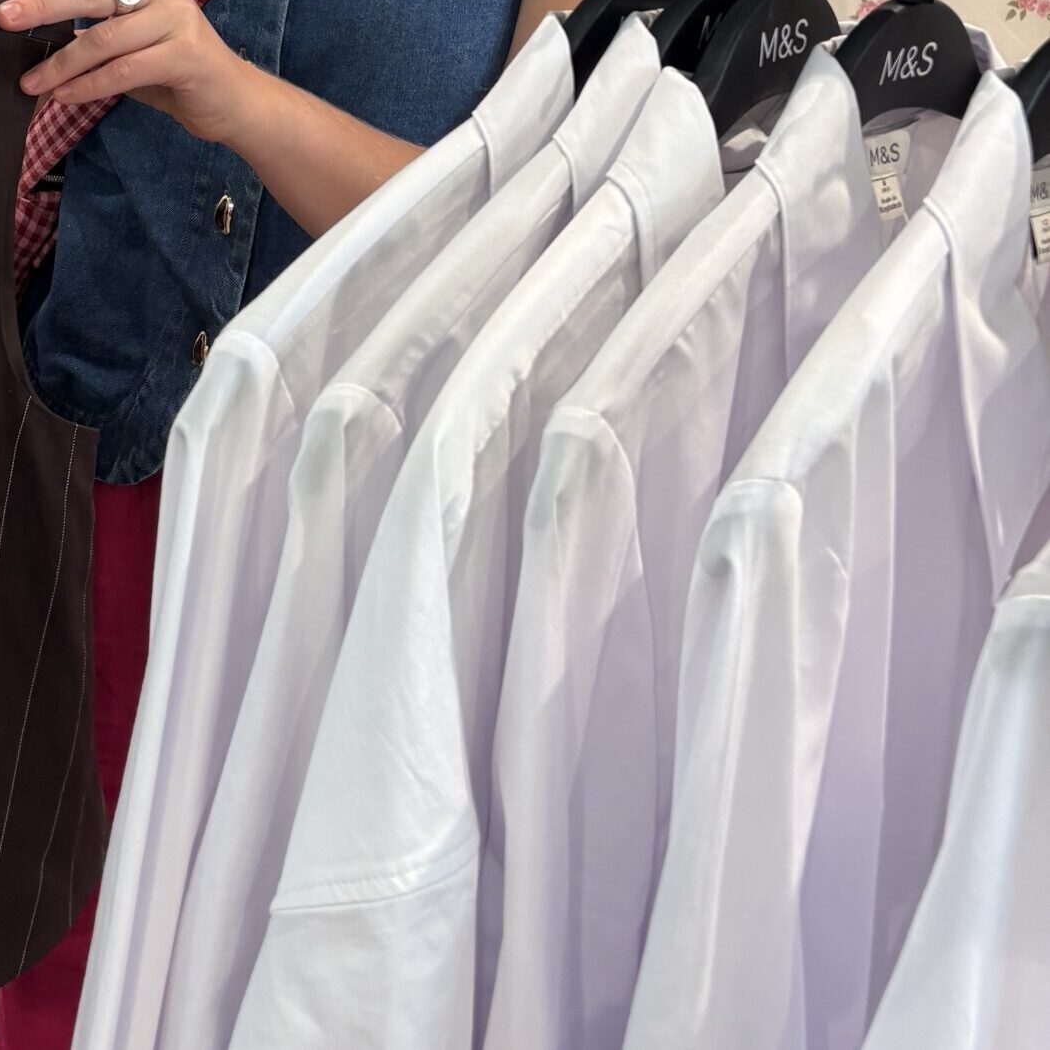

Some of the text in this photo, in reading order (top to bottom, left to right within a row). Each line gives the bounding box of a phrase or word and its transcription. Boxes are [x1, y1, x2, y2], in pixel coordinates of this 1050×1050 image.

[759, 18, 809, 68] M&S
[879, 41, 938, 87] M&S
[869, 142, 900, 167] M&S
[1030, 181, 1050, 203] M&
